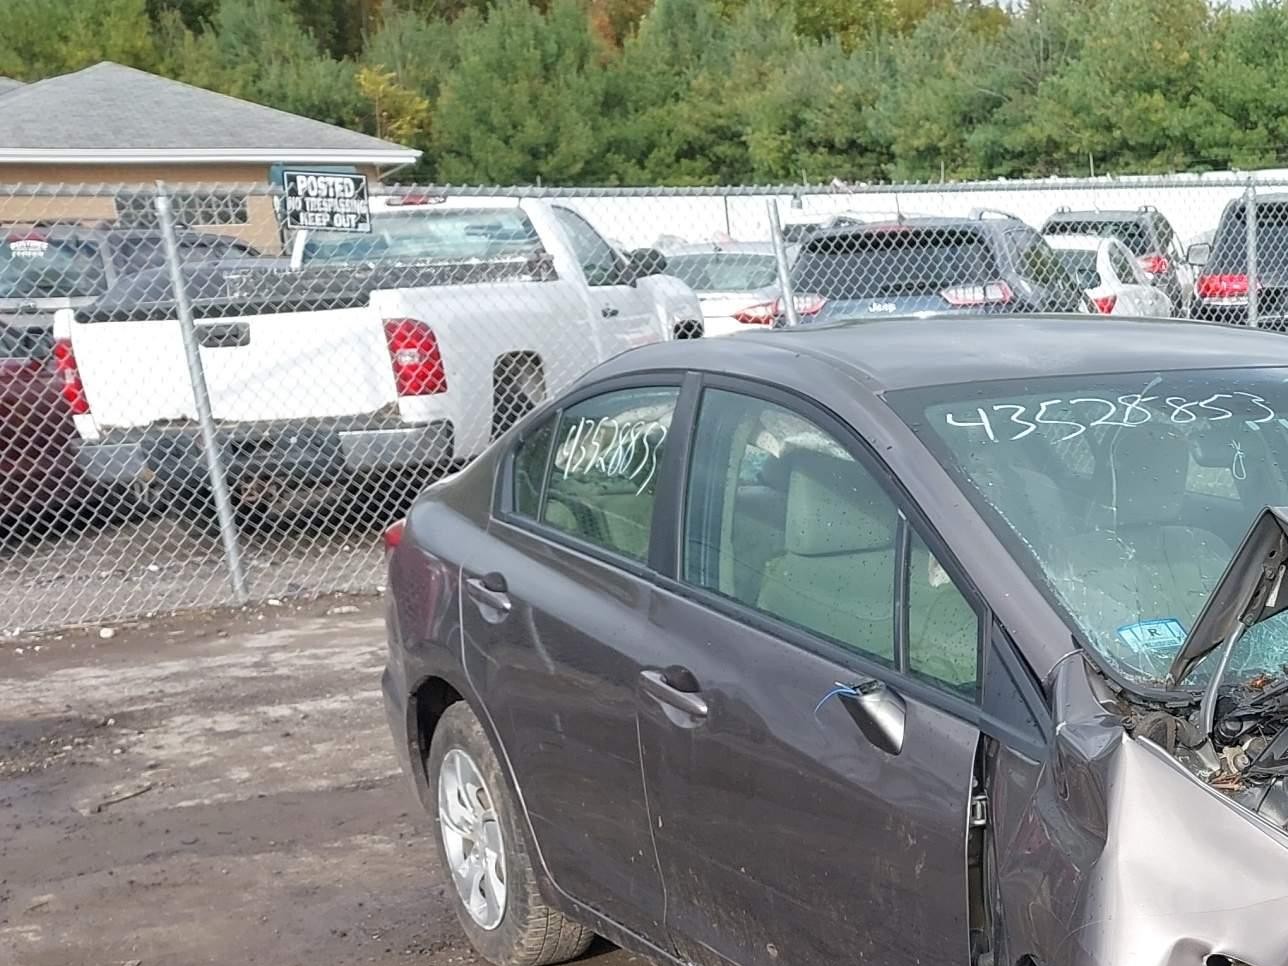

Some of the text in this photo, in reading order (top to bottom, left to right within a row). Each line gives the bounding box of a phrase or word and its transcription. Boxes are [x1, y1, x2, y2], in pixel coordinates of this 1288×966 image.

[296, 175, 355, 198] POSTED
[287, 196, 367, 213] NO TRESPASSING
[300, 211, 357, 228] KEEP OUT
[946, 391, 1275, 443] 43528853
[562, 416, 668, 497] 43528853
